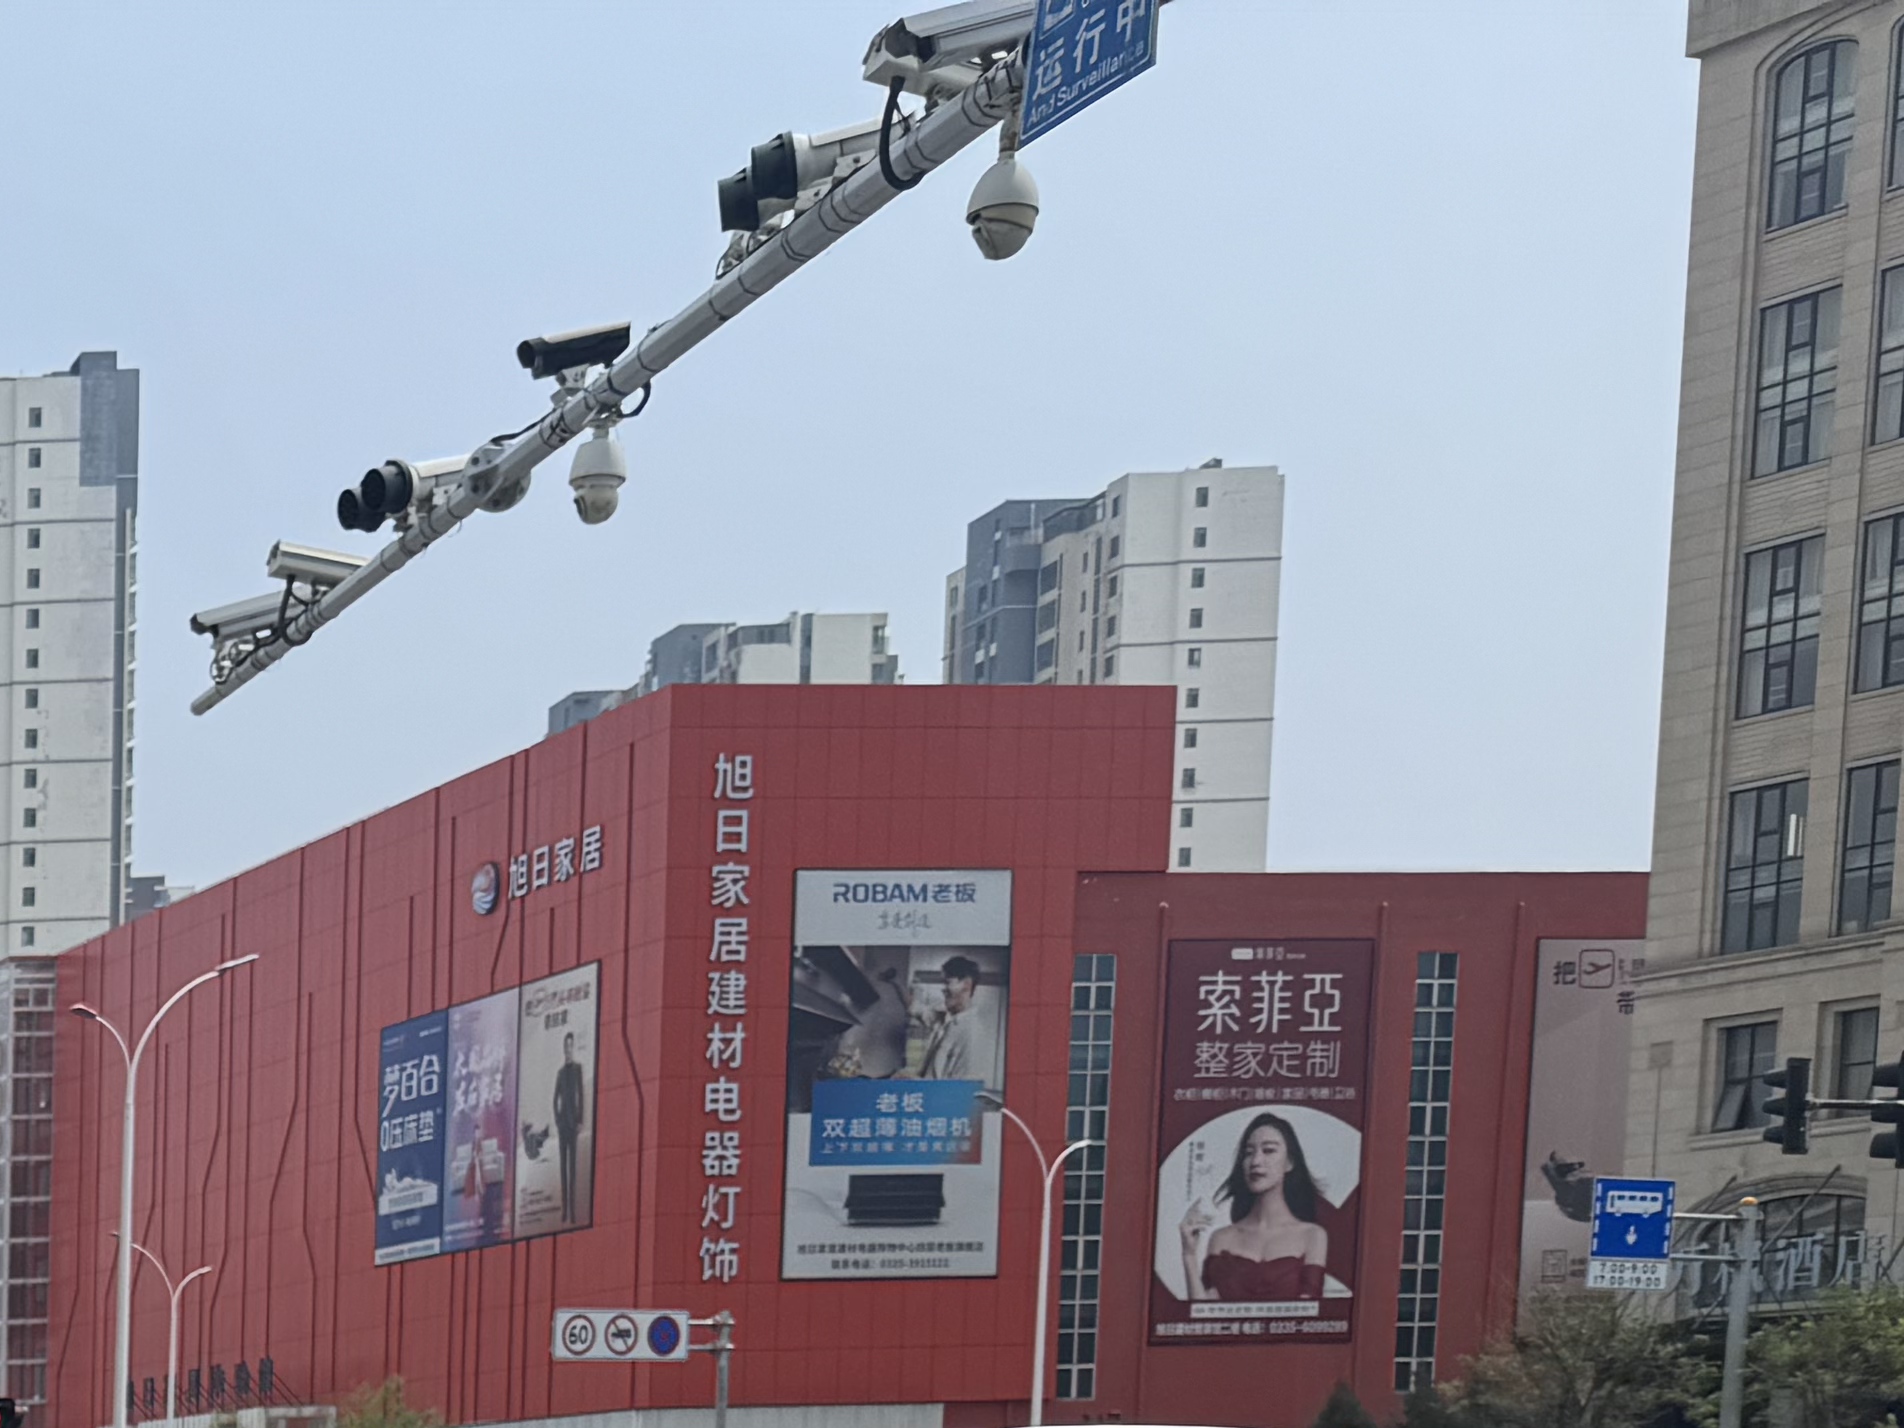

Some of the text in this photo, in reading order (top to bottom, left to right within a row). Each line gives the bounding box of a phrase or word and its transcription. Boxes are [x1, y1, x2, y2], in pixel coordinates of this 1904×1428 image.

[1032, 0, 1146, 101] 运行中
[508, 824, 601, 900] 旭日家居
[833, 883, 977, 903] ROBAM 老板
[699, 752, 755, 1283] 旭日家居建材电器灯饰
[1194, 1040, 1341, 1079] 整家定制
[382, 1055, 440, 1117] 梦百合
[876, 1091, 924, 1113] 老板
[822, 1117, 972, 1138] 双超薄油烟机
[569, 1325, 589, 1345] 60
